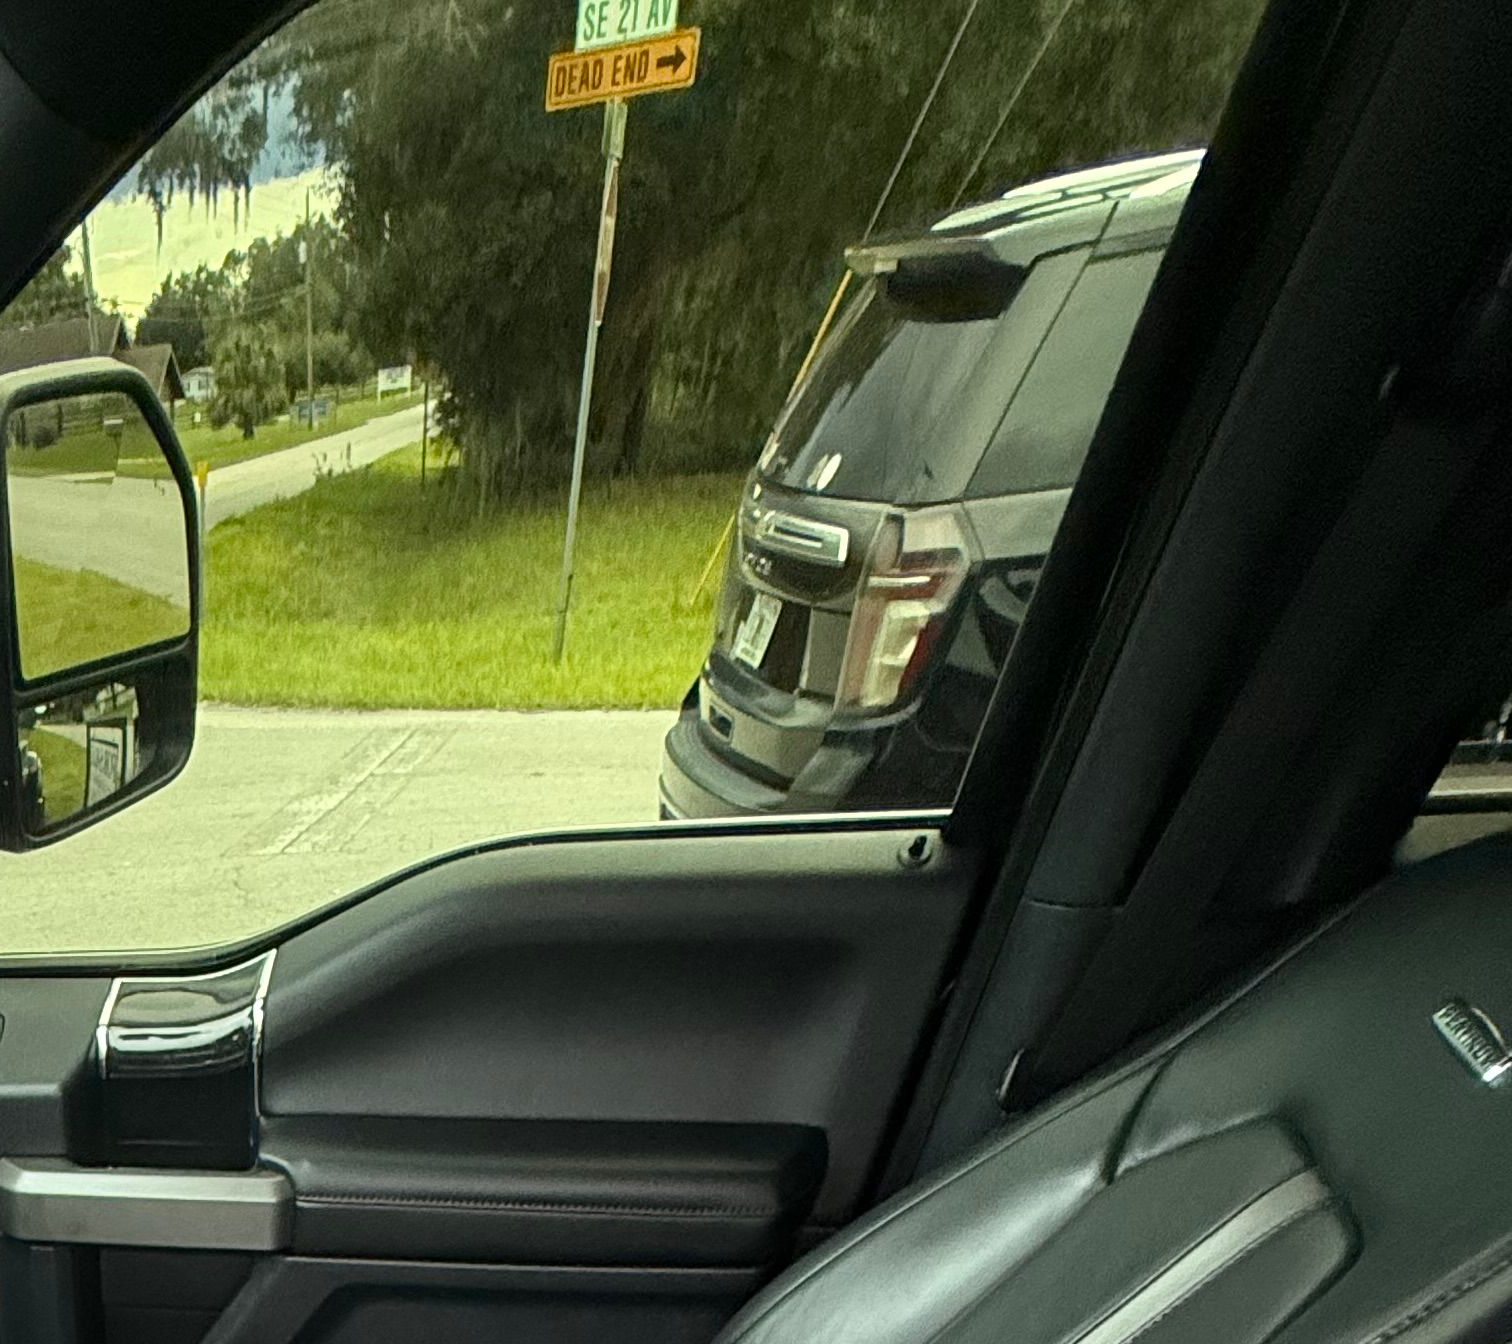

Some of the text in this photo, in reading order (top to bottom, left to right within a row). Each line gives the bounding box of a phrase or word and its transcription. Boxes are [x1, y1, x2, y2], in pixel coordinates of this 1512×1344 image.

[583, 0, 672, 42] SE 21 AV
[554, 49, 650, 97] DEAD END
